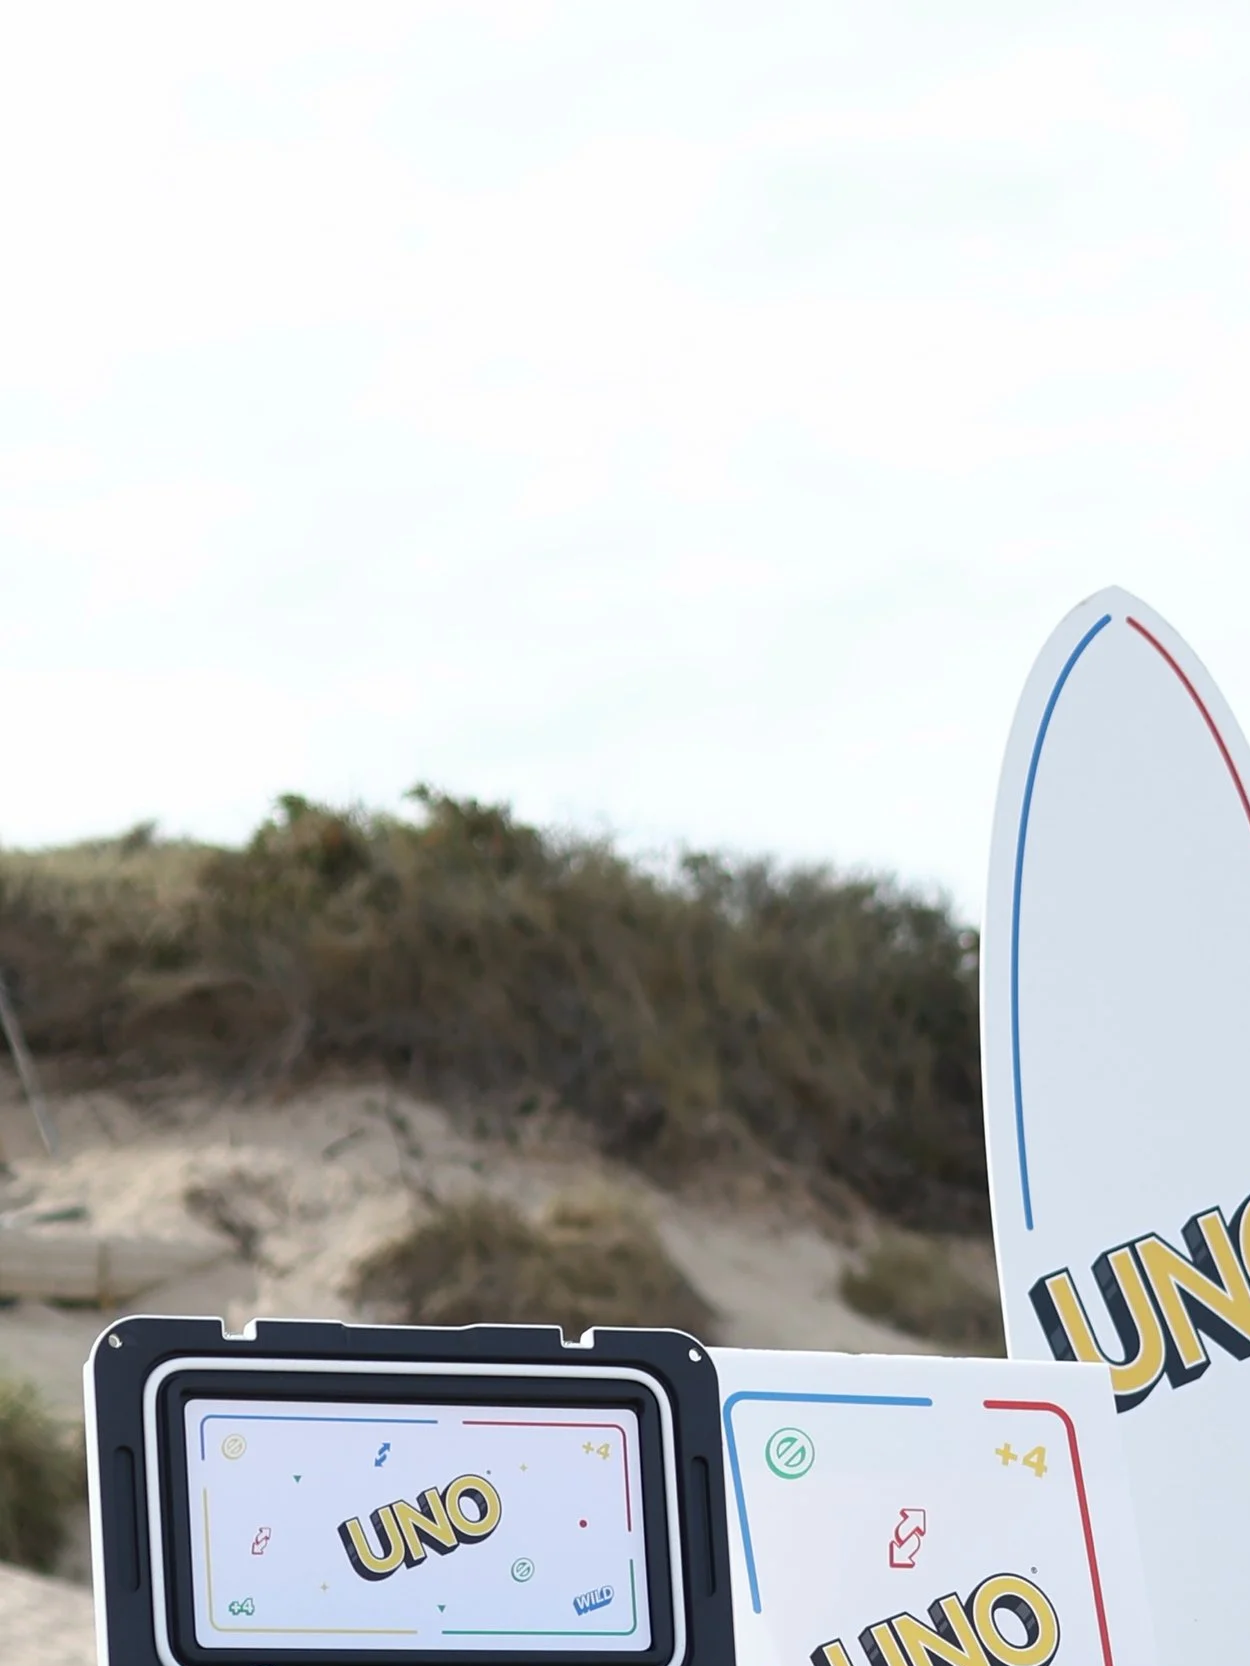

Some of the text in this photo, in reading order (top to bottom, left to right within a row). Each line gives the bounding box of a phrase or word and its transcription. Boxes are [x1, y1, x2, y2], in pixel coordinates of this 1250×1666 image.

[582, 1441, 610, 1460] +4
[994, 1442, 1047, 1478] +4
[338, 1473, 502, 1581] UNO
[228, 1597, 255, 1616] +4
[573, 1585, 614, 1616] WILD
